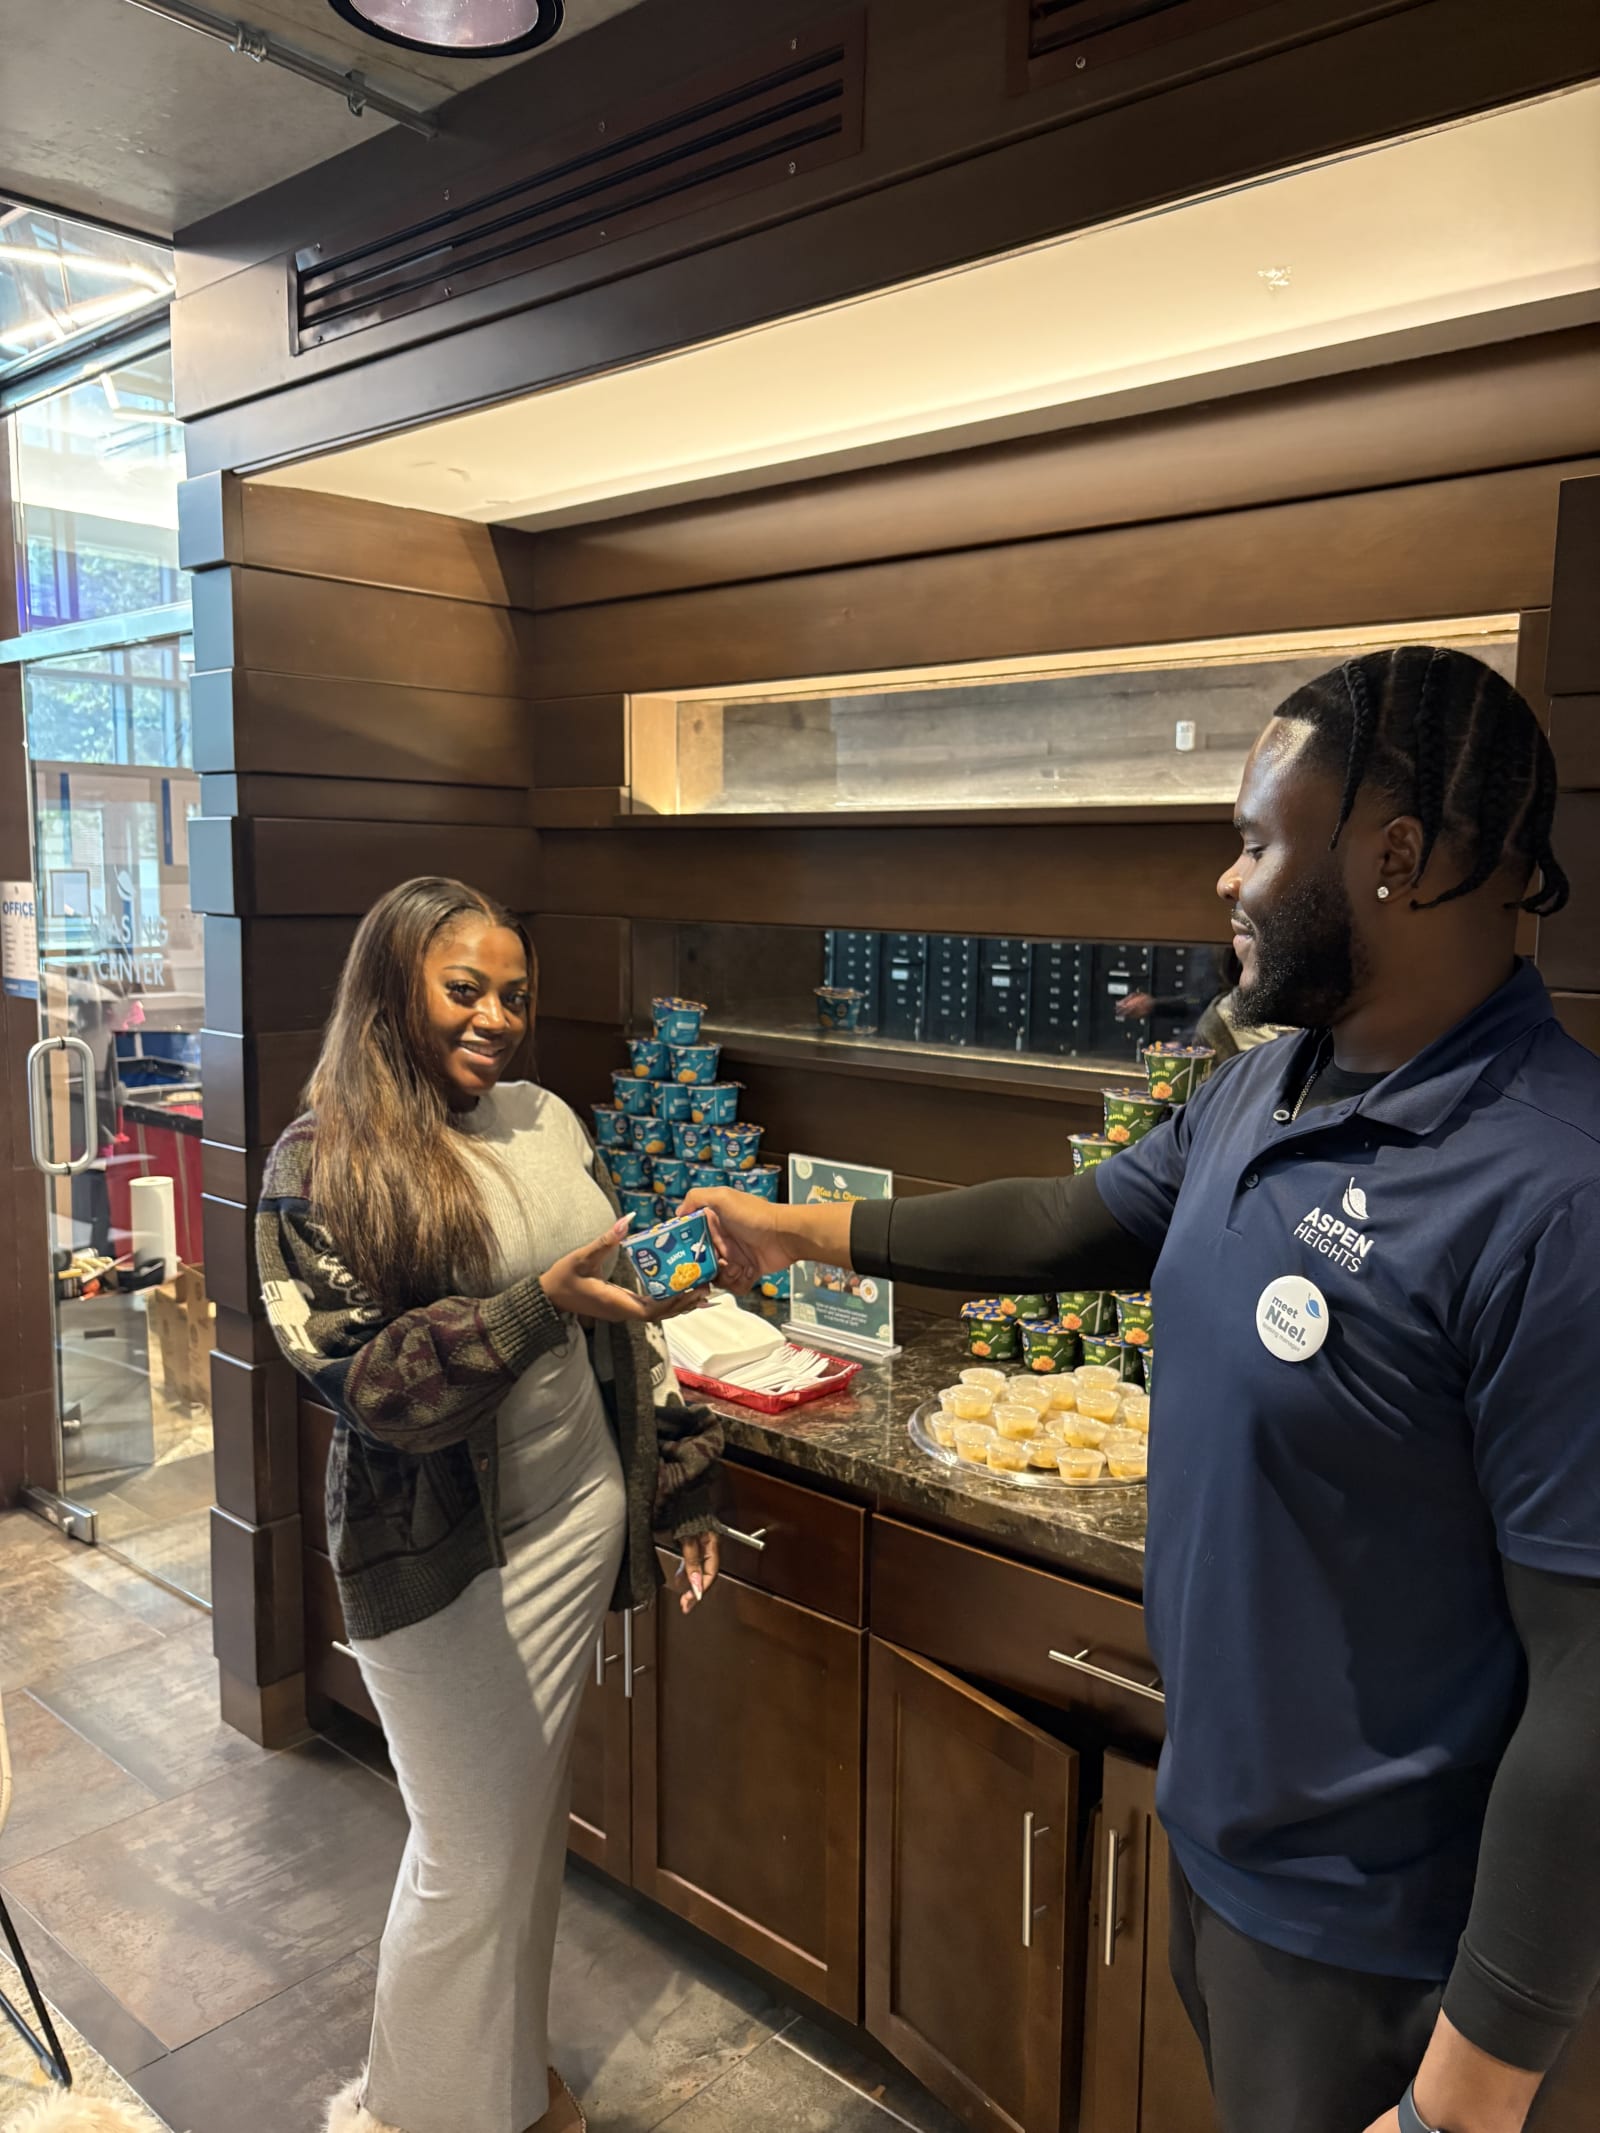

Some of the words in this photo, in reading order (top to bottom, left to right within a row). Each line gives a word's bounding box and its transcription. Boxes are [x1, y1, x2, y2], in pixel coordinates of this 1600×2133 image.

[3, 901, 34, 917] OFFICE
[97, 951, 165, 986] CENTER
[1293, 1222, 1362, 1273] HEIGHTS
[1303, 1206, 1375, 1258] ASPEN
[1265, 1304, 1307, 1346] Nuel.
[1271, 1296, 1298, 1319] meet
